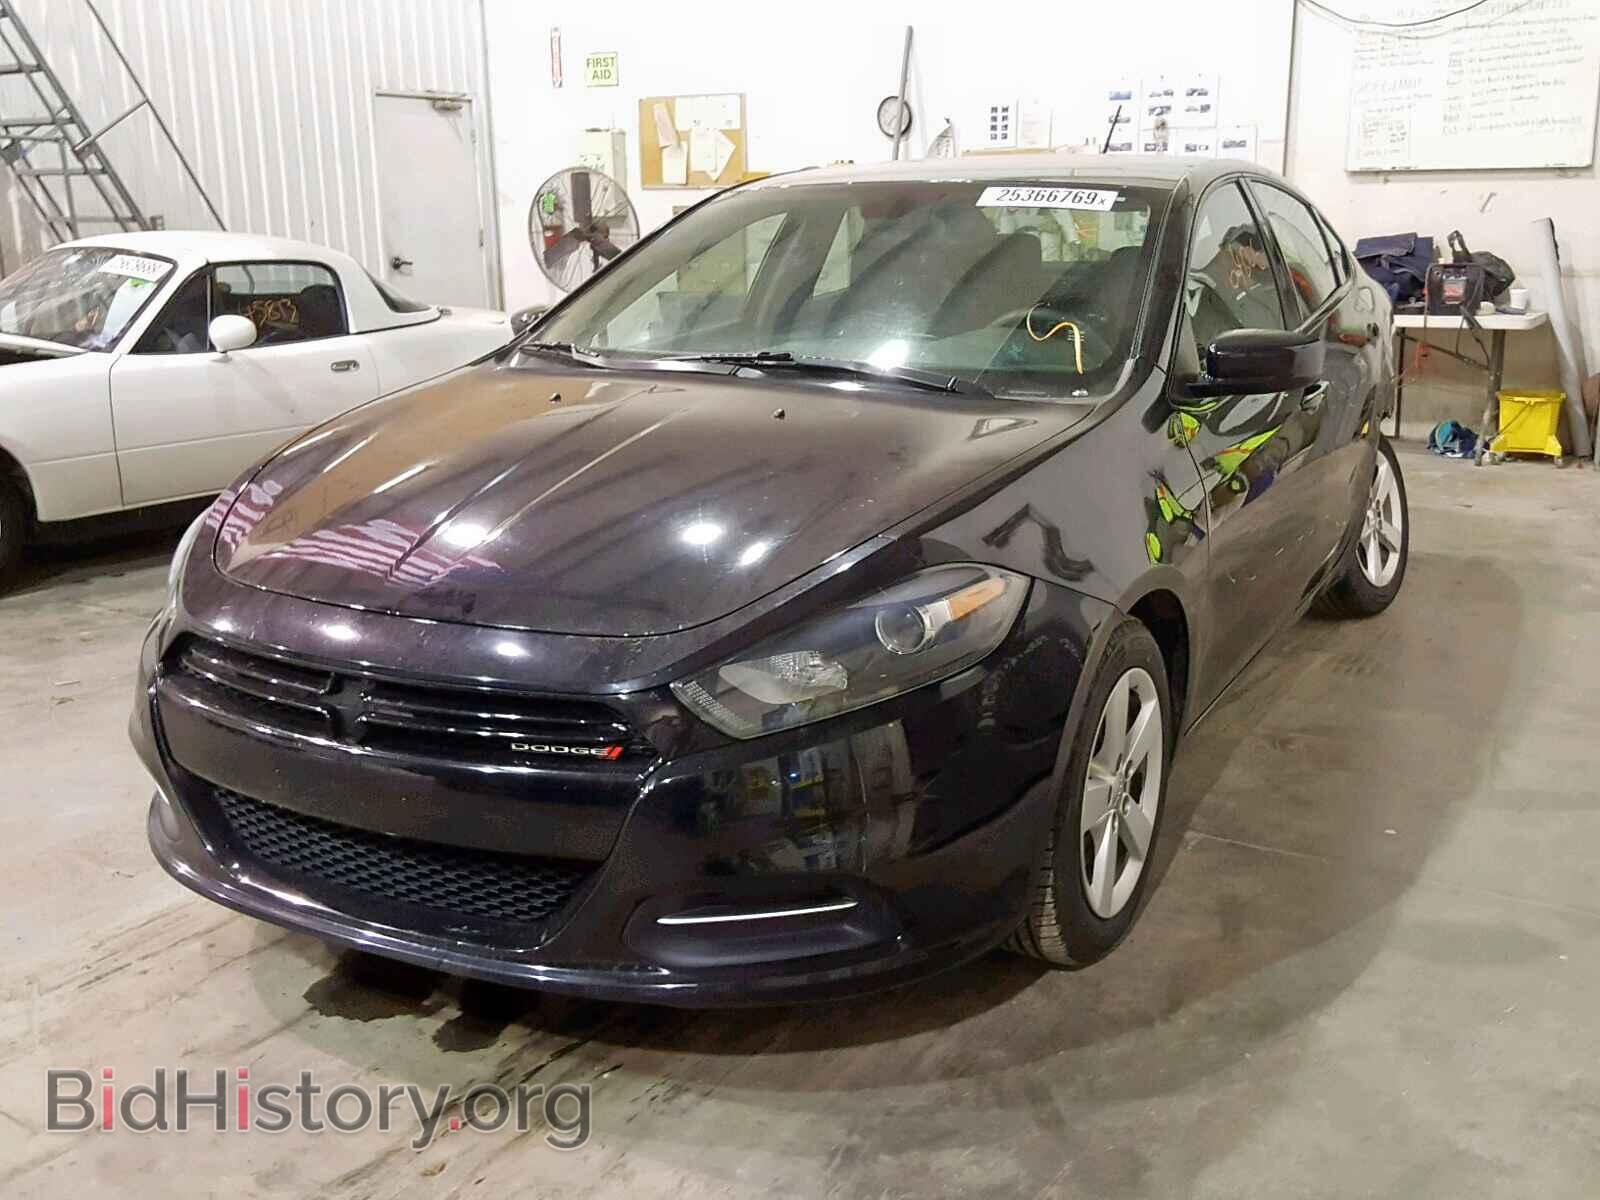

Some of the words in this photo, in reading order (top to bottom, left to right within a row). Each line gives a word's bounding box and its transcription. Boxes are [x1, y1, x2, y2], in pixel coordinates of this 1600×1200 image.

[586, 57, 615, 69] FIRST
[592, 69, 612, 81] AID
[511, 743, 609, 757] DODGE
